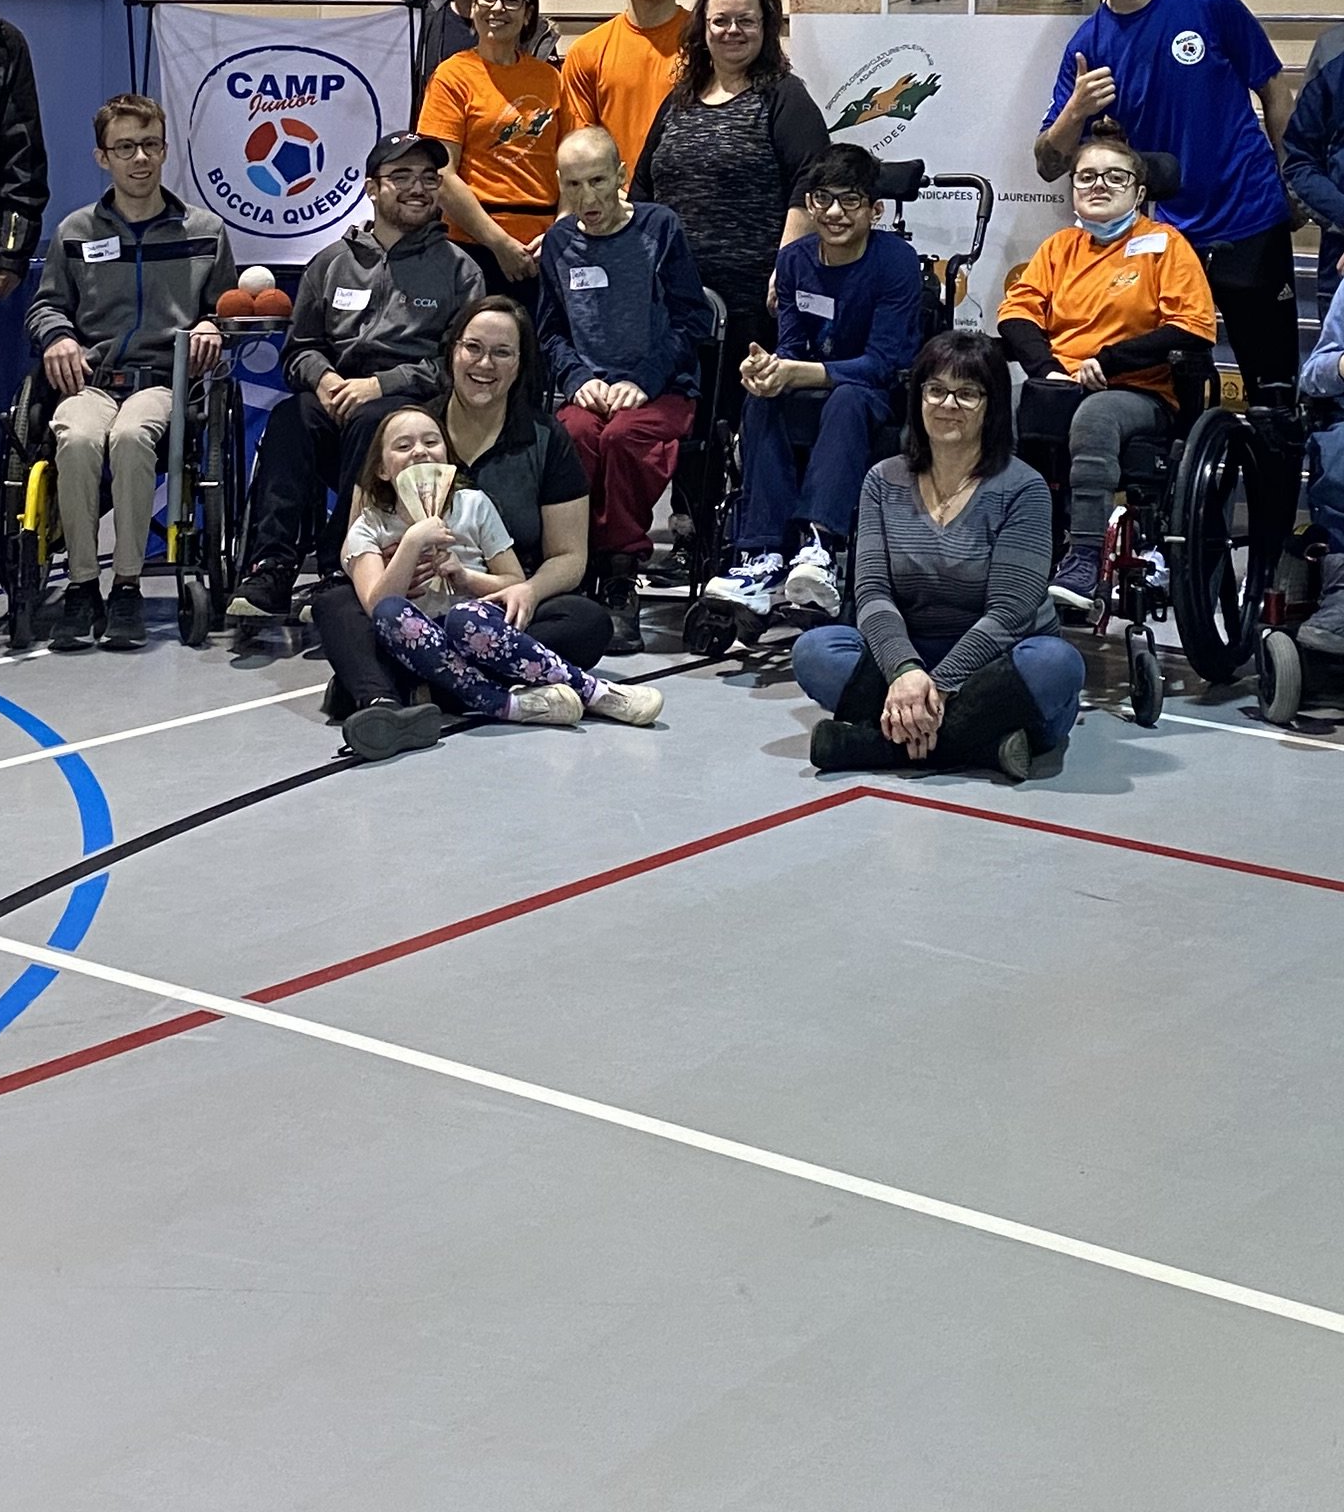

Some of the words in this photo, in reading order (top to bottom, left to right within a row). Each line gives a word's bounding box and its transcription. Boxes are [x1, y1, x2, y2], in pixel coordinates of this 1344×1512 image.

[227, 72, 345, 101] CAMP
[248, 93, 318, 122] Junior
[207, 167, 274, 225] BOCCIA
[282, 166, 360, 225] QUÉBEC
[998, 192, 1065, 204] LAURENTIDES
